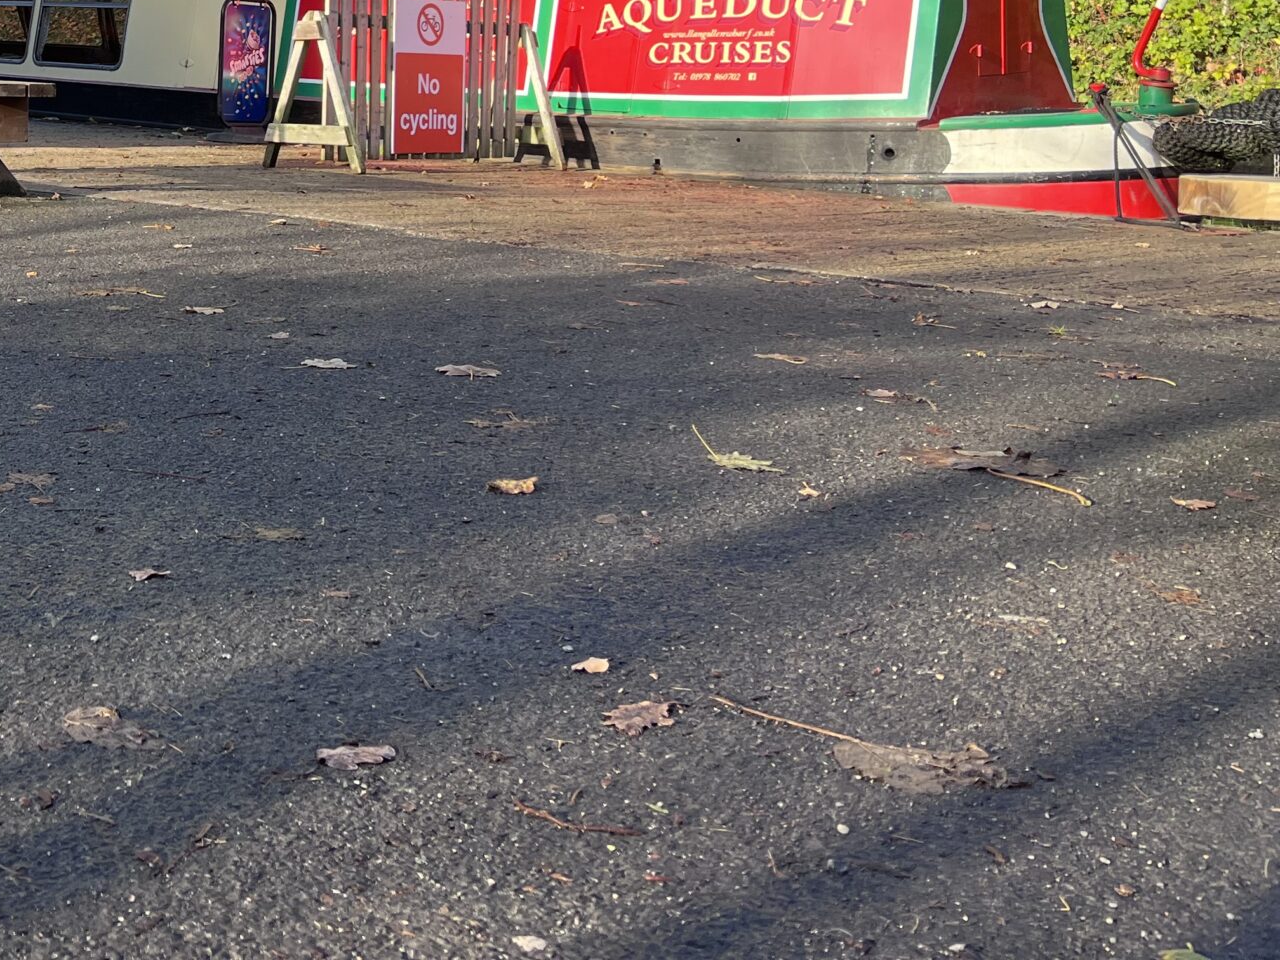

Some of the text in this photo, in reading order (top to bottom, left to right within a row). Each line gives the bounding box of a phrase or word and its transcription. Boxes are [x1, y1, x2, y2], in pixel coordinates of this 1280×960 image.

[648, 40, 791, 64] CRUISES
[417, 73, 440, 95] No
[690, 72, 711, 81] 01978
[400, 109, 458, 136] cycling
